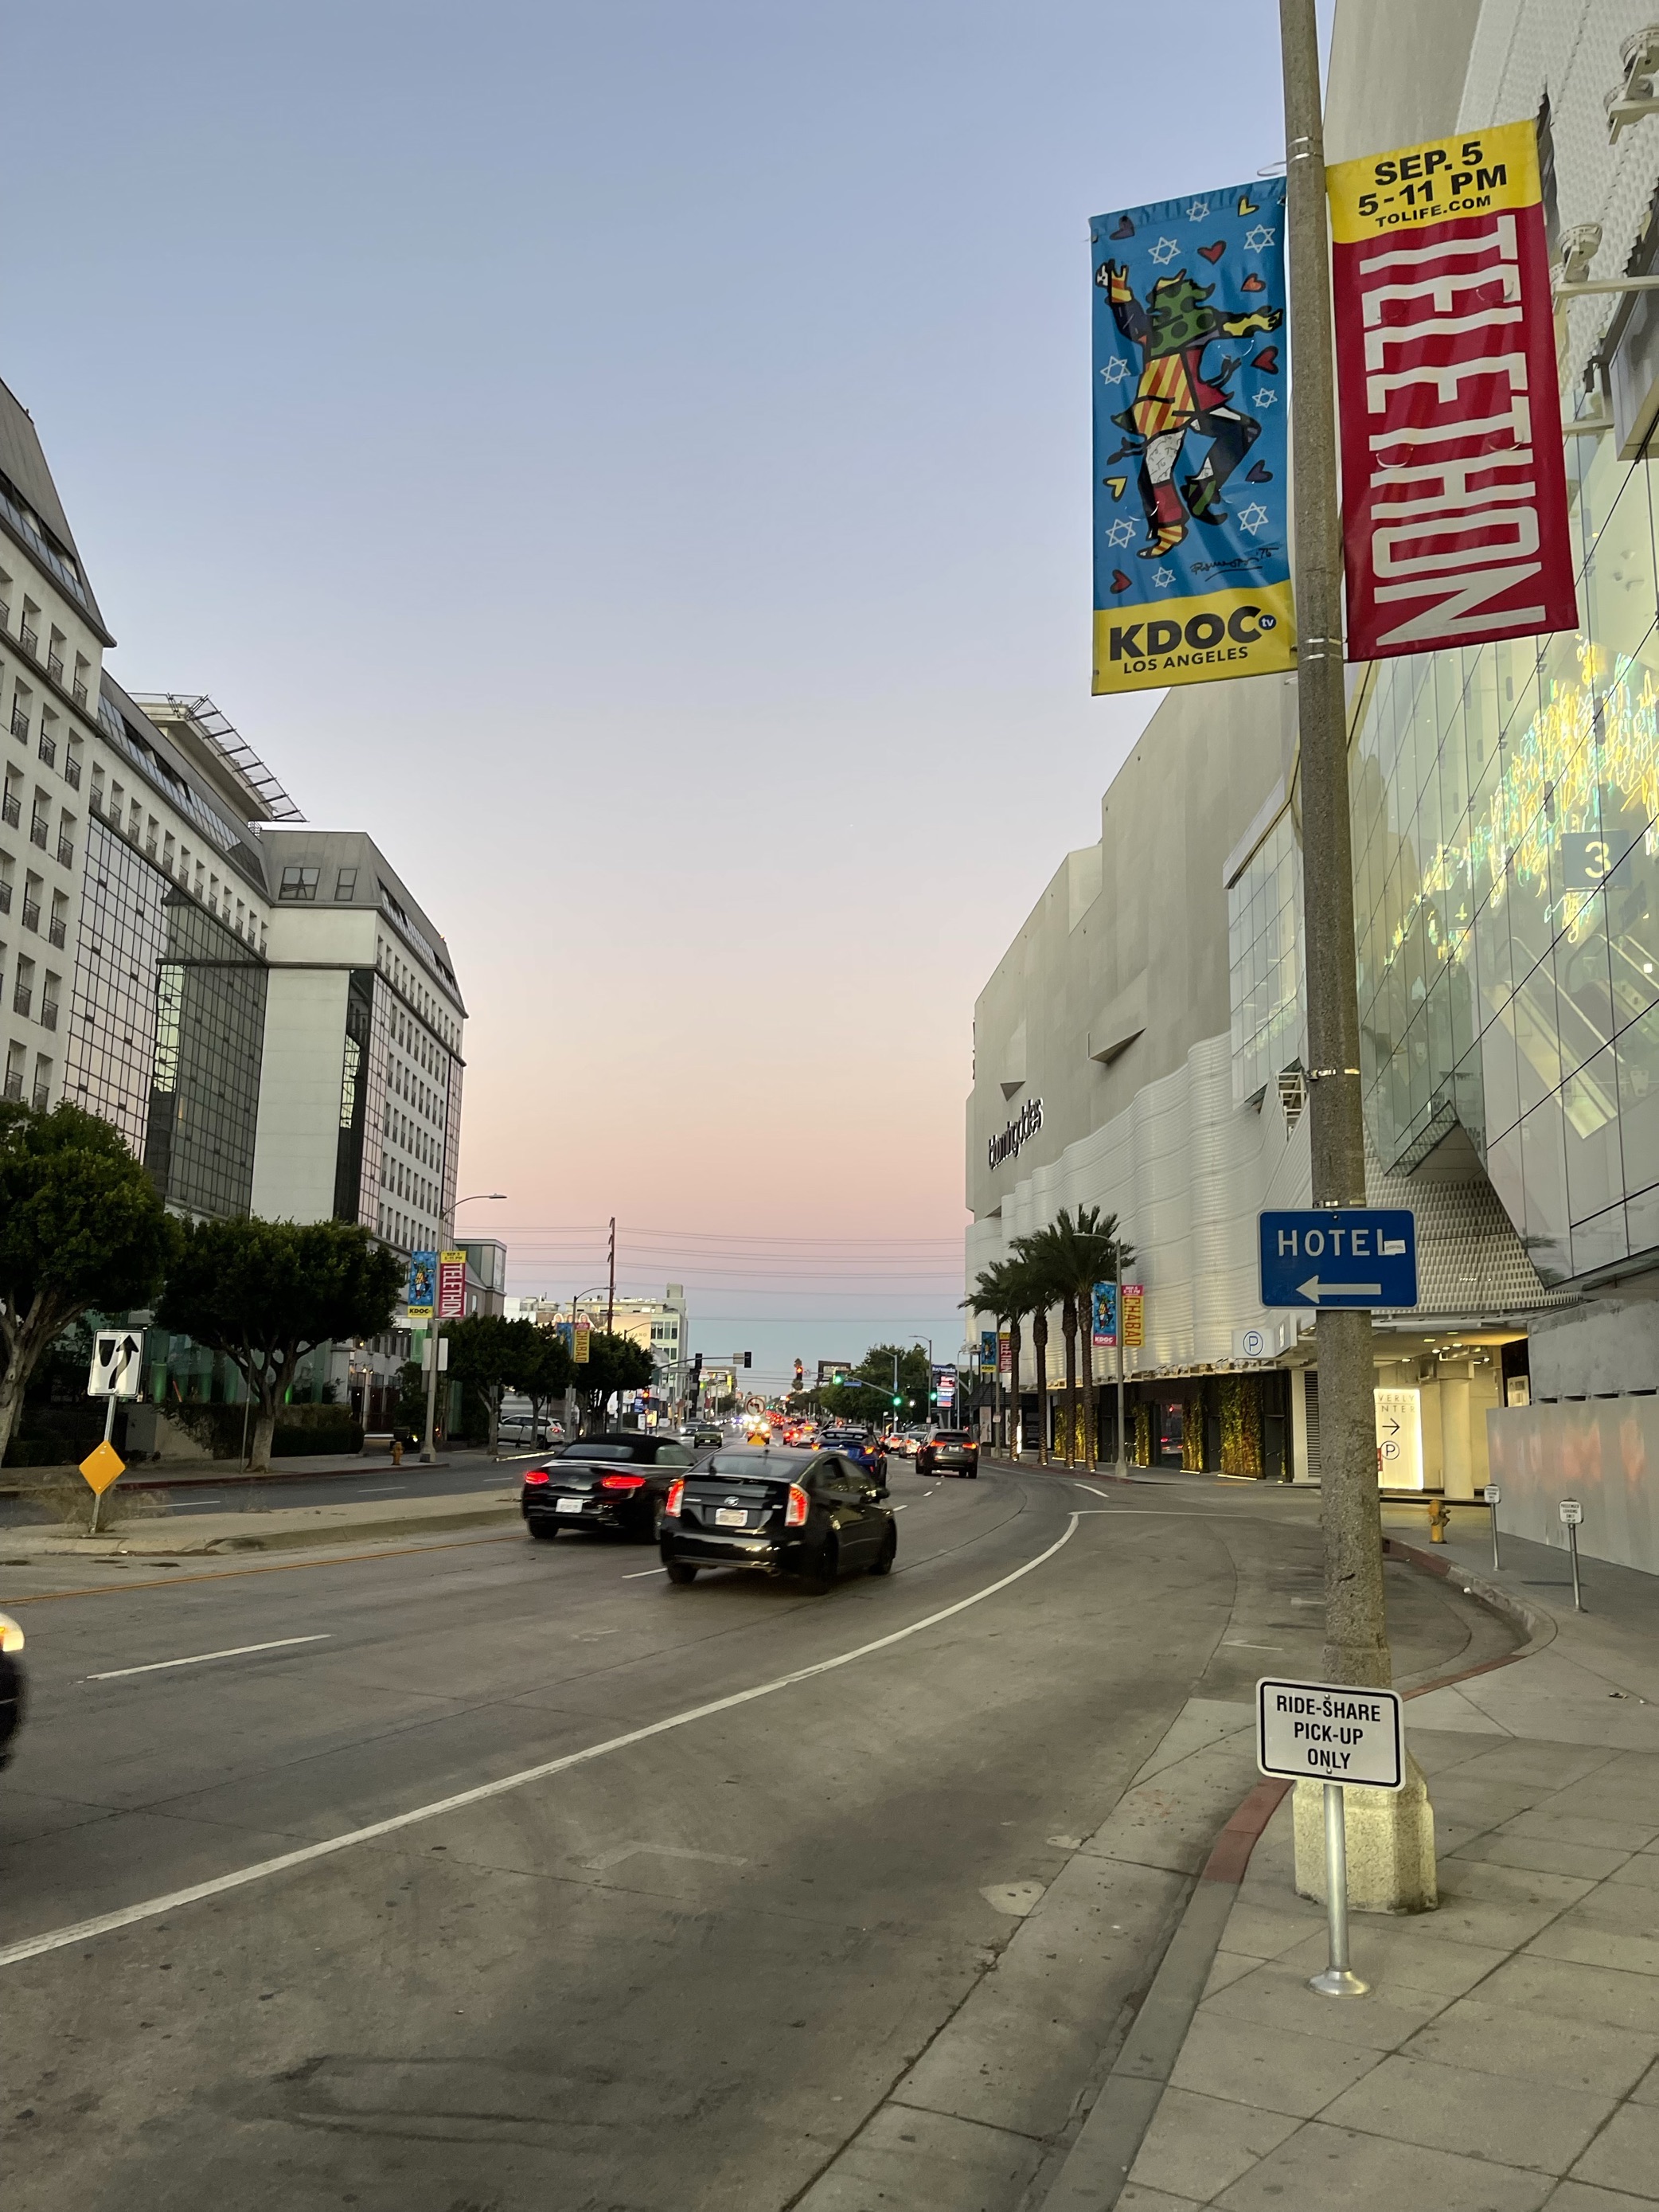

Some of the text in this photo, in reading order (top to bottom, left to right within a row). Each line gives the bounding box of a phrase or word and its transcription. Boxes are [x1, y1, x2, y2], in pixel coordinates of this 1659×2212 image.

[1375, 141, 1484, 186] SEP. 5
[1358, 164, 1507, 217] 5-11 PM
[1375, 195, 1491, 227] TOLIFE.COM
[1359, 214, 1547, 646] TELETHON
[1110, 605, 1275, 661] KDOC tv
[1123, 647, 1248, 674] LOS ANGELES
[1585, 841, 1611, 878] 3
[1278, 1229, 1396, 1256] HOTEL
[441, 1264, 463, 1318] TELETHON
[1124, 1297, 1142, 1346] CHABAD
[576, 1330, 587, 1362] CHABAD
[1385, 1444, 1396, 1457] P
[1277, 1695, 1380, 1722] RIDE-SHARE
[1294, 1722, 1364, 1745] PICK-UP
[1307, 1748, 1351, 1769] ONLY
